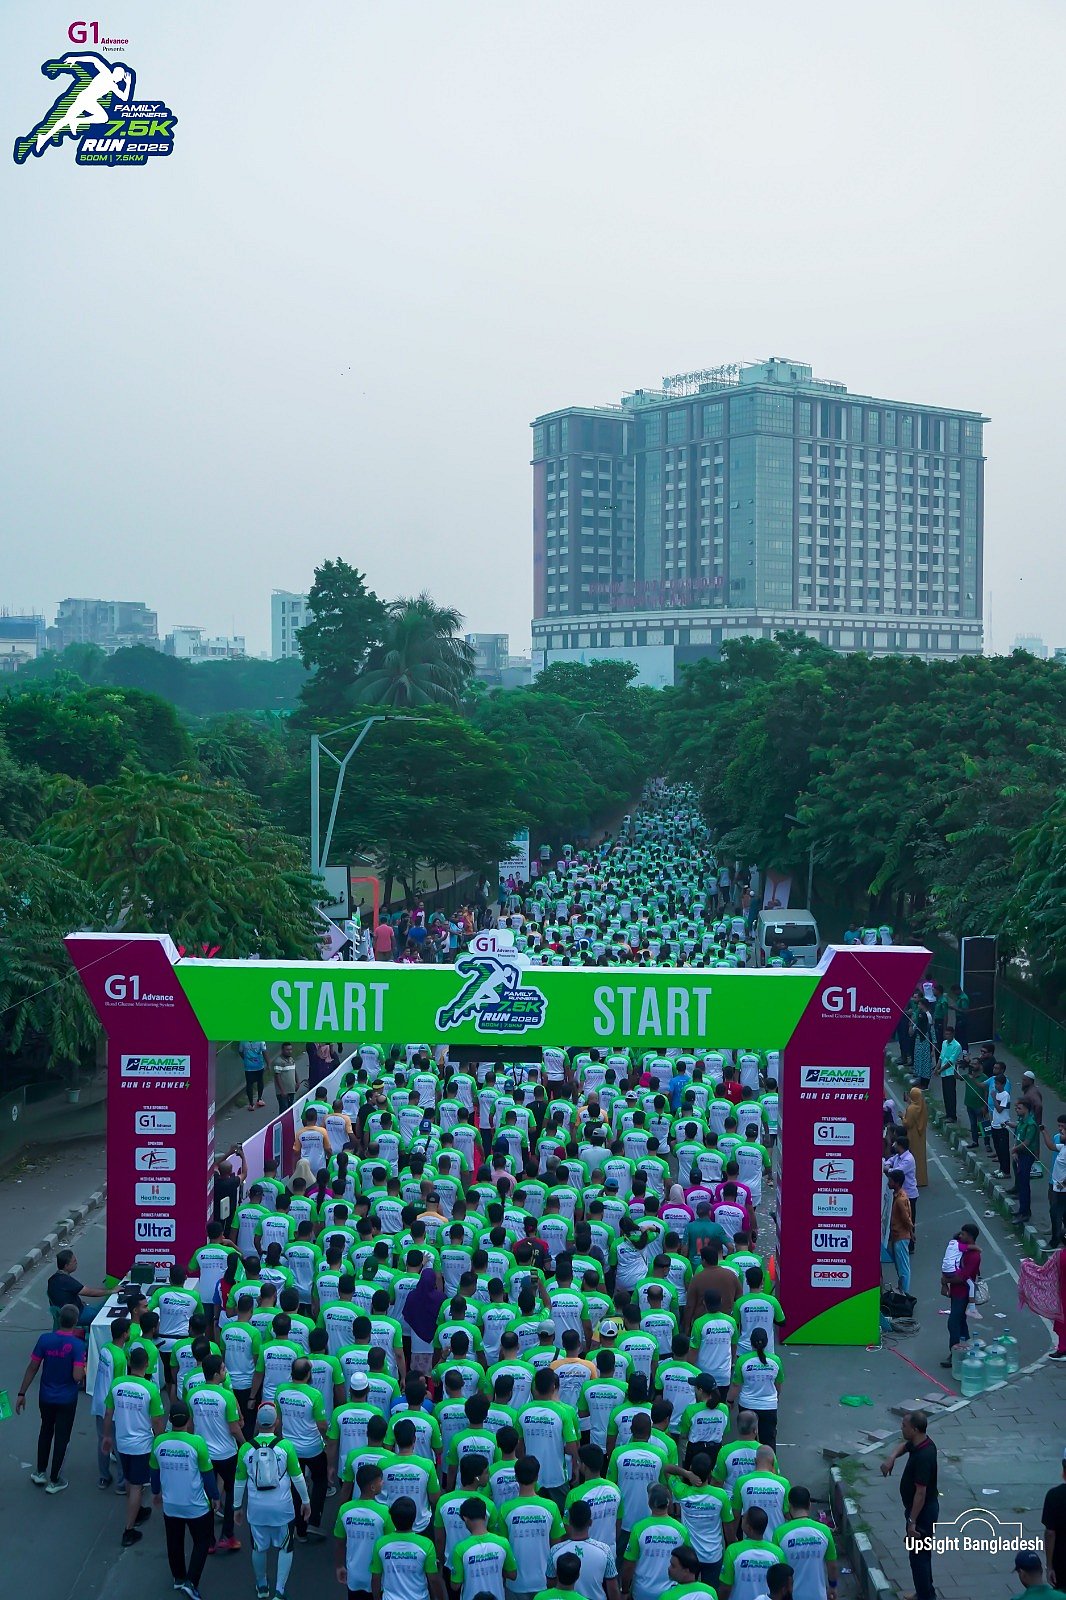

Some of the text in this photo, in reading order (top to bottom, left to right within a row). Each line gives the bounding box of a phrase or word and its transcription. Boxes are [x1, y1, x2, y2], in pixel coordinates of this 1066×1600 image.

[476, 937, 496, 952] G1
[105, 974, 140, 1000] G1
[270, 980, 389, 1032] START
[822, 986, 856, 1012] G1
[497, 1002, 541, 1012] 7.5K
[594, 986, 712, 1036] START
[482, 1013, 511, 1021] RUN
[140, 1115, 156, 1127] G1
[818, 1126, 834, 1138] G1
[138, 1223, 172, 1237] Ultra
[814, 1234, 848, 1248] Ultra
